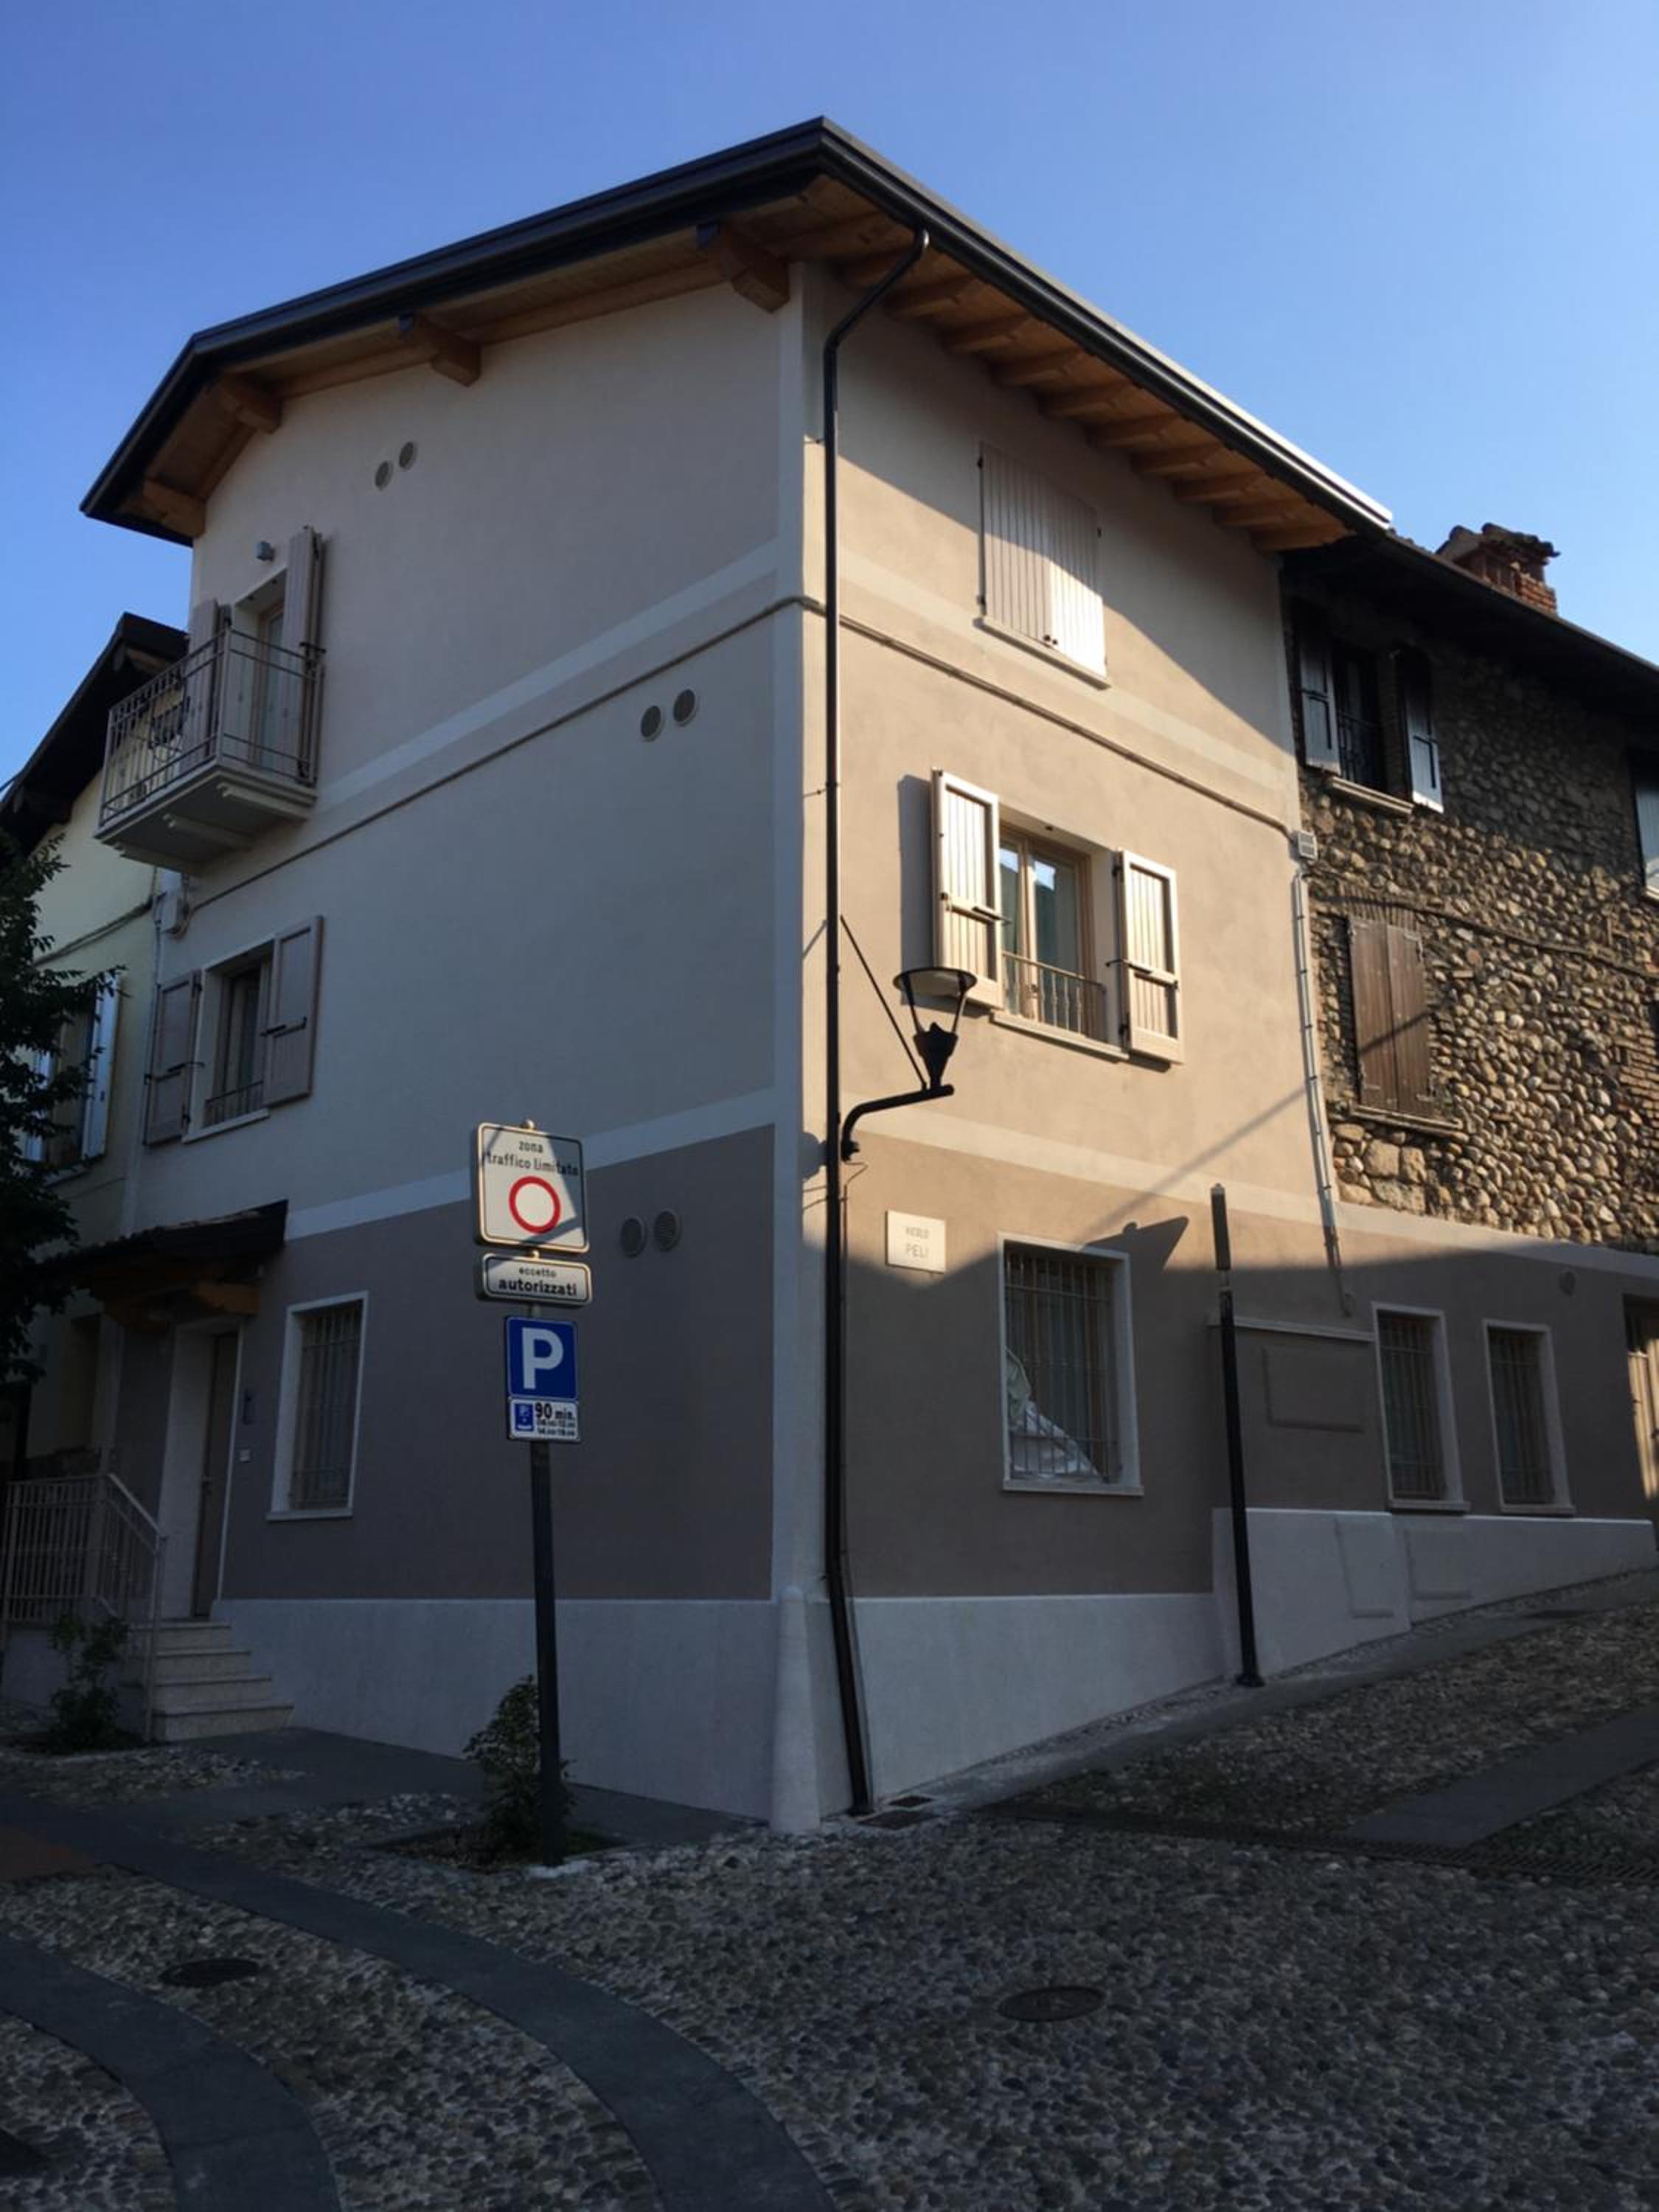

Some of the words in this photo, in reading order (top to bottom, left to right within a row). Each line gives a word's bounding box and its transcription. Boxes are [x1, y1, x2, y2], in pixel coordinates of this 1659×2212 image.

[519, 1141, 543, 1153] zona
[487, 1152, 531, 1170] traffico
[519, 1265, 557, 1278] eccetto
[498, 1278, 577, 1297] autorizzati
[522, 1326, 564, 1390] P
[535, 1402, 552, 1418] 90
